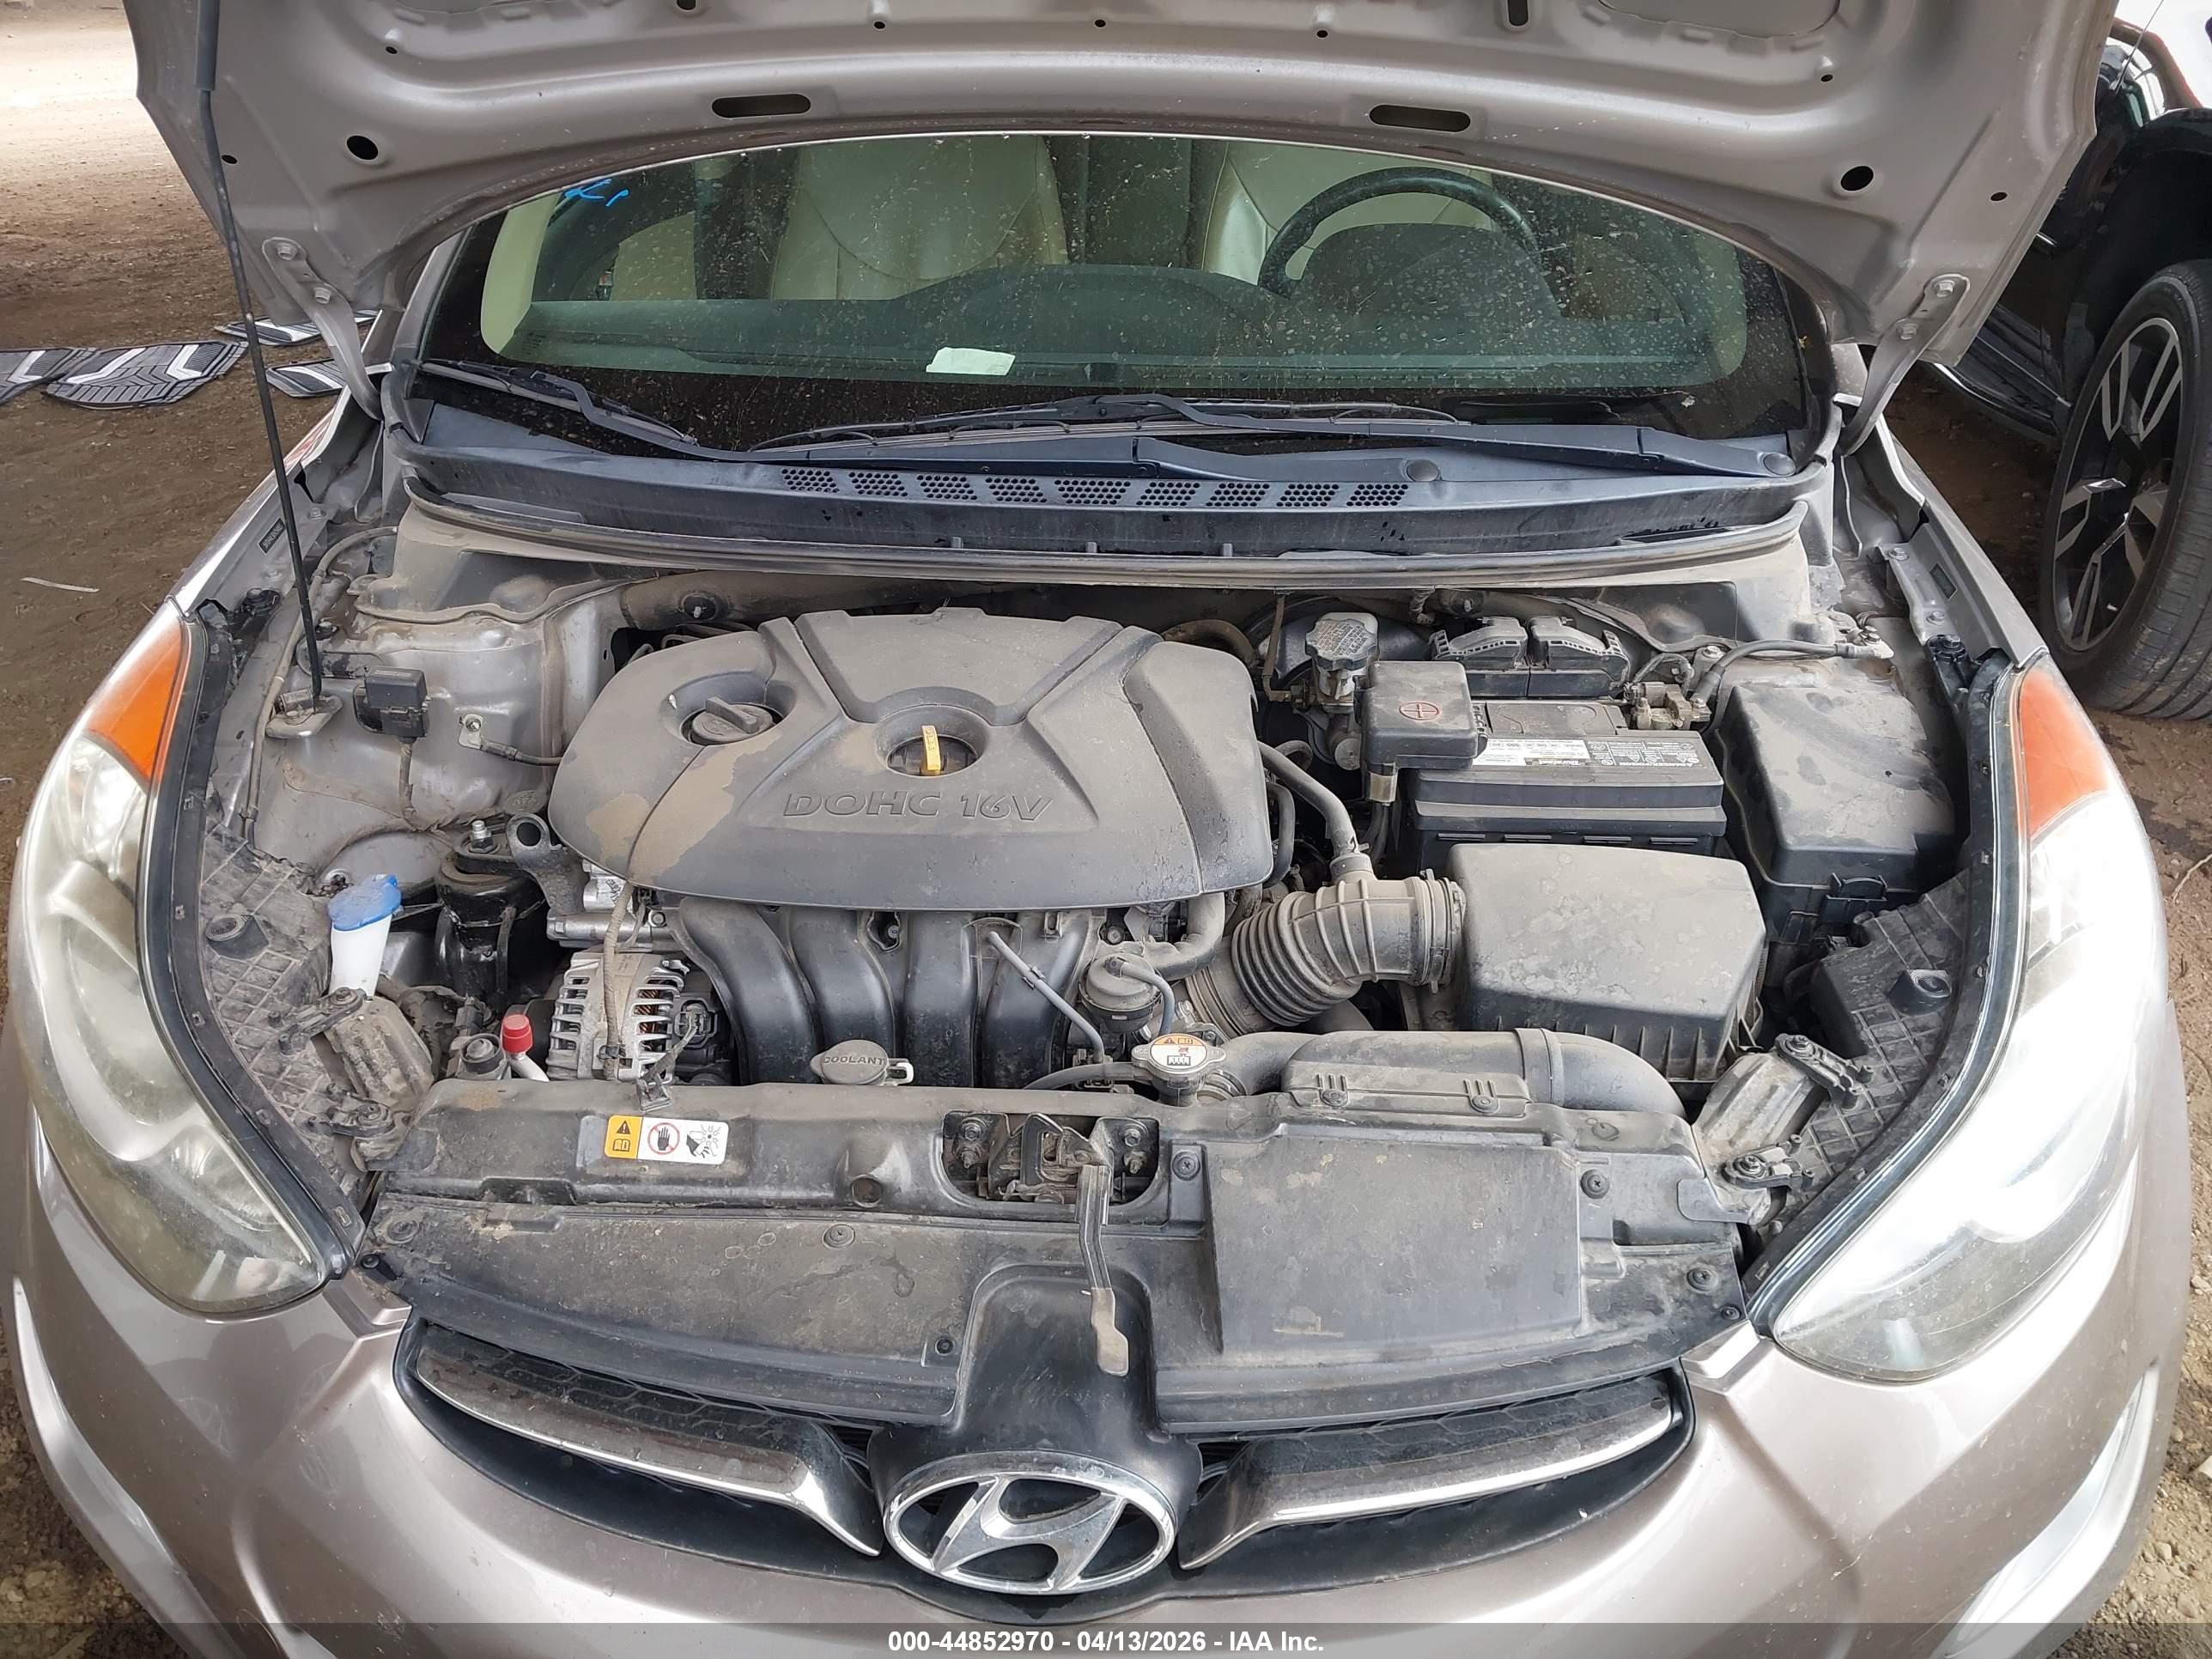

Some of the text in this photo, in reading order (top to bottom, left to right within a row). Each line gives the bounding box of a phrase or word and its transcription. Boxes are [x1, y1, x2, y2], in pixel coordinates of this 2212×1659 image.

[782, 790, 1054, 821] DOHC 16V
[823, 1056, 886, 1066] COOLANT
